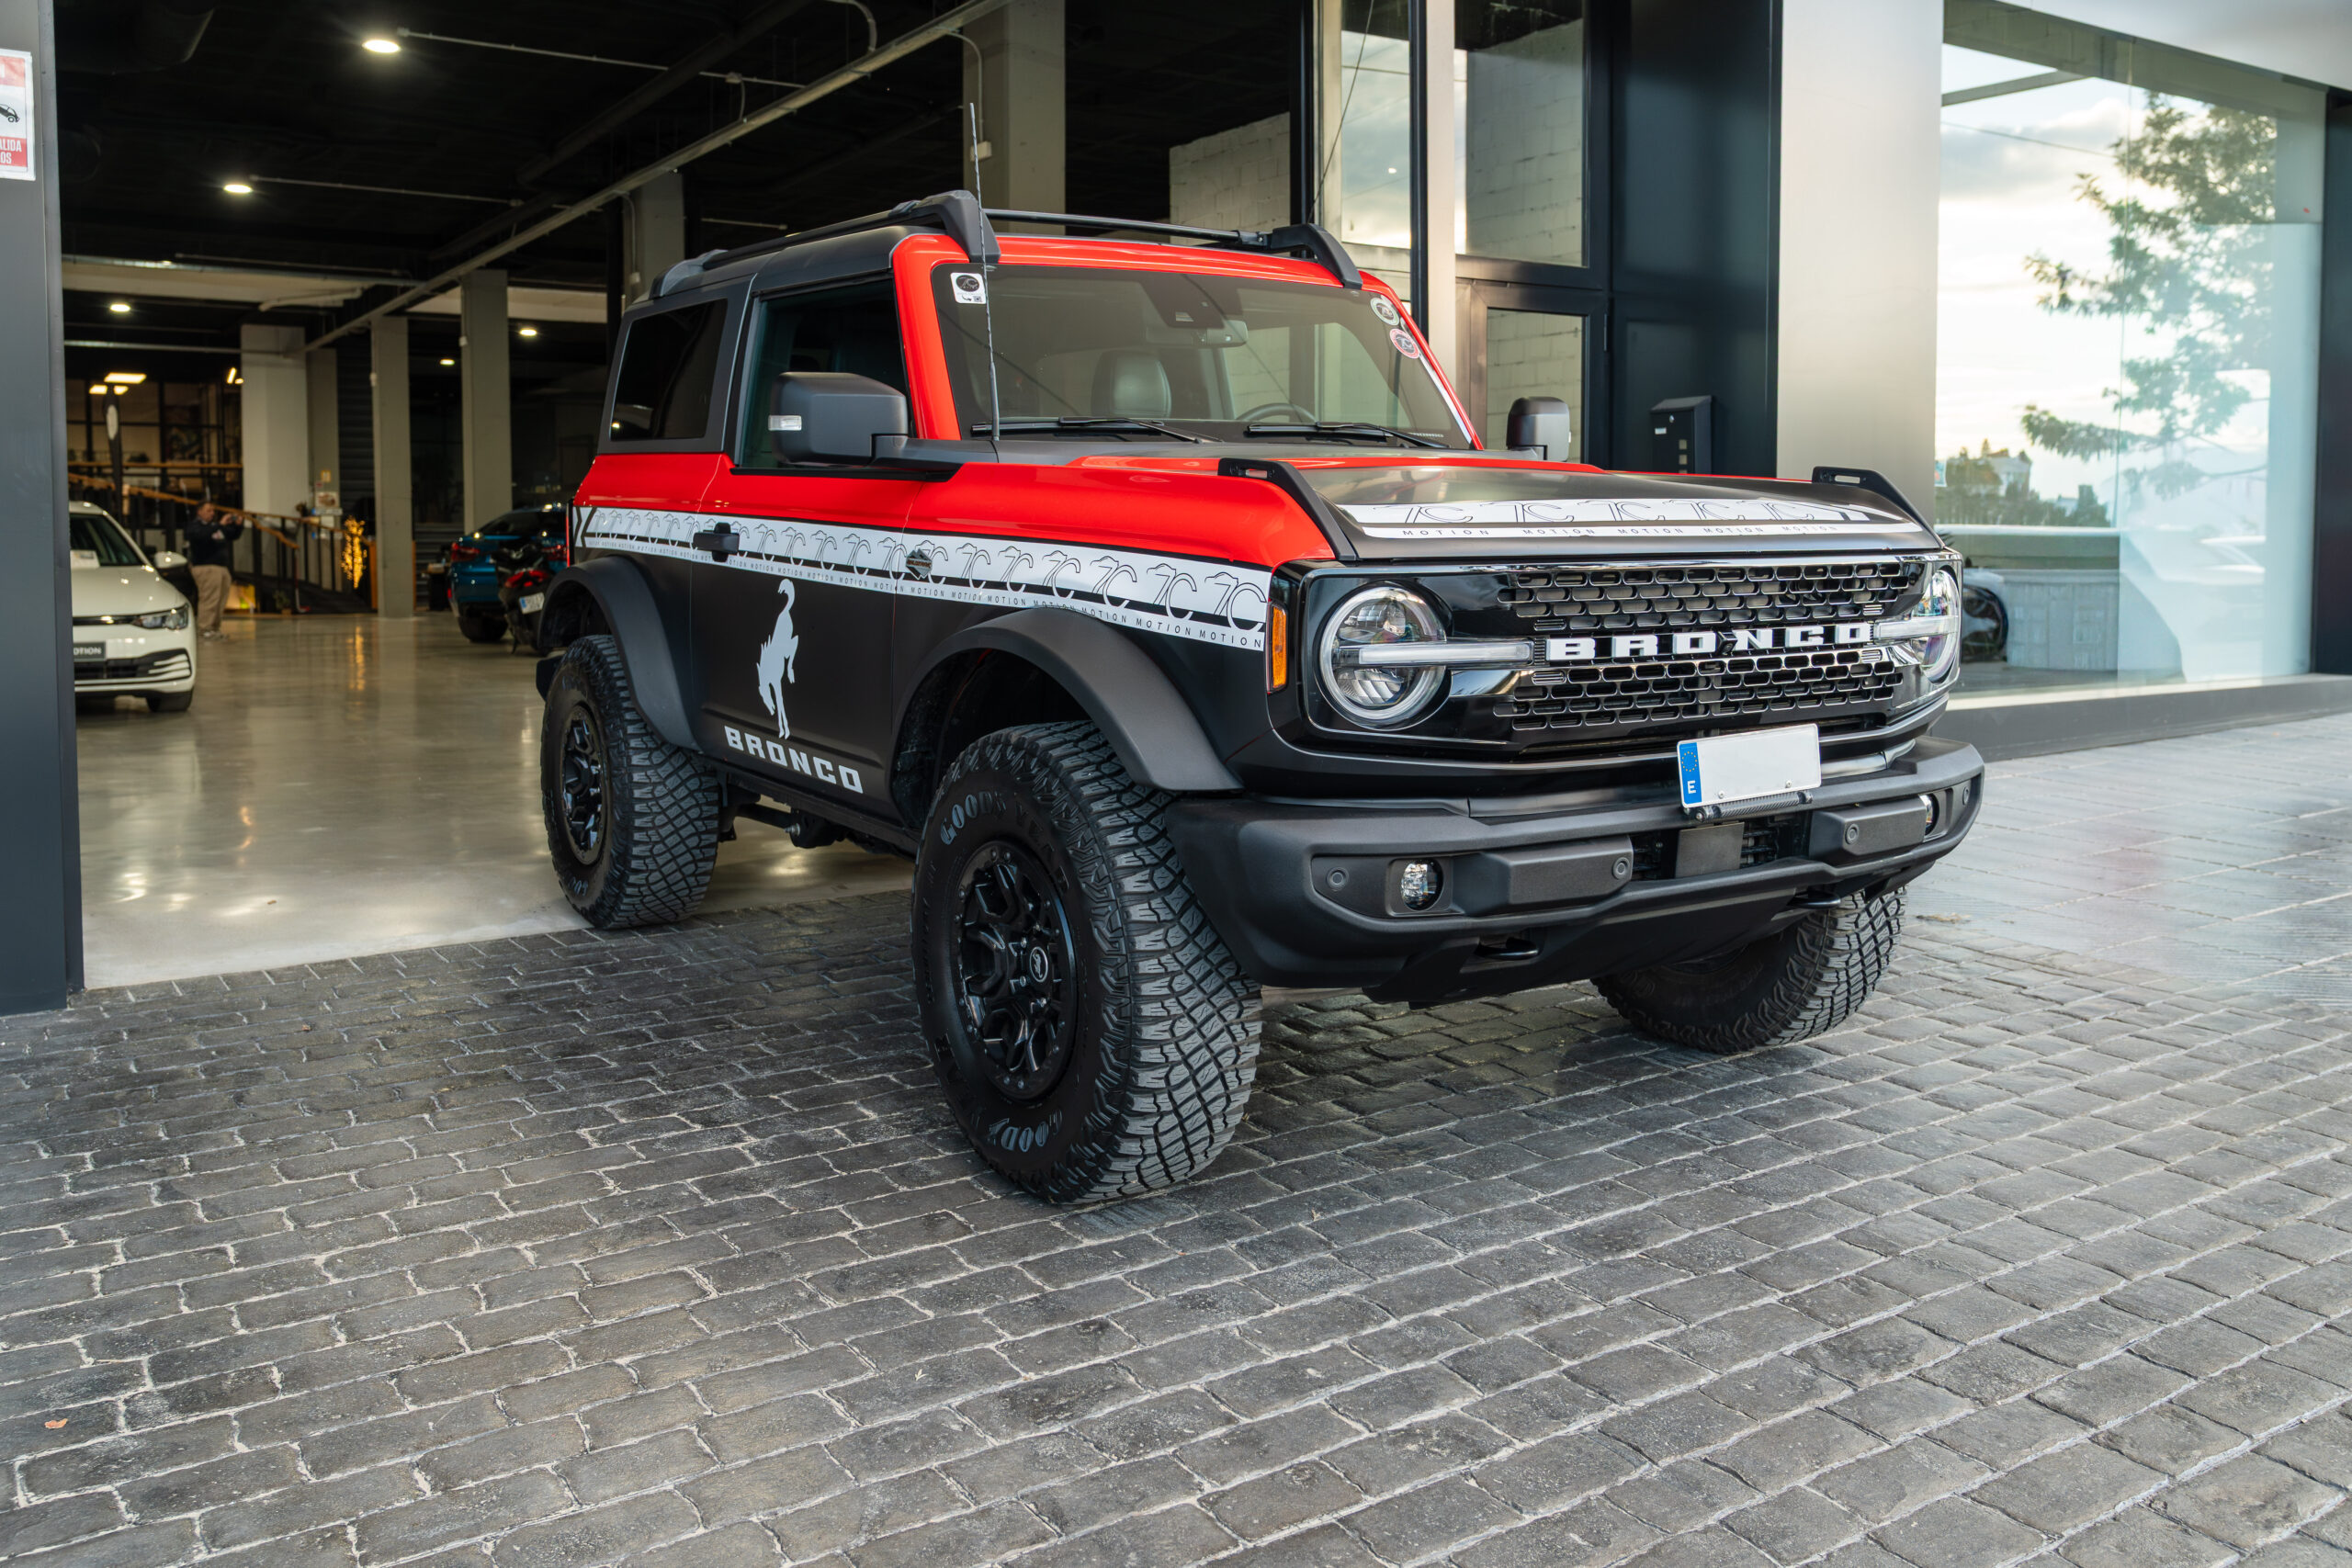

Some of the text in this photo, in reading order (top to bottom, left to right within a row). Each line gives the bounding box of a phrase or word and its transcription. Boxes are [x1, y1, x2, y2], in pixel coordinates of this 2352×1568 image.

[0, 139, 22, 152] LIDA
[751, 563, 774, 572] MOTION
[777, 567, 803, 577] MOTION
[807, 572, 834, 581] MOTION
[839, 577, 868, 587] MOTION
[874, 582, 904, 592] MOTION
[910, 587, 944, 597] MOTION
[952, 592, 981, 602] MOTION
[988, 595, 1026, 606] MOTION
[1136, 618, 1191, 636] MOTION
[1200, 629, 1261, 648] MOTION
[1546, 622, 1871, 661] BRONCO
[724, 726, 864, 794] BRONCO
[1687, 780, 1697, 795] E
